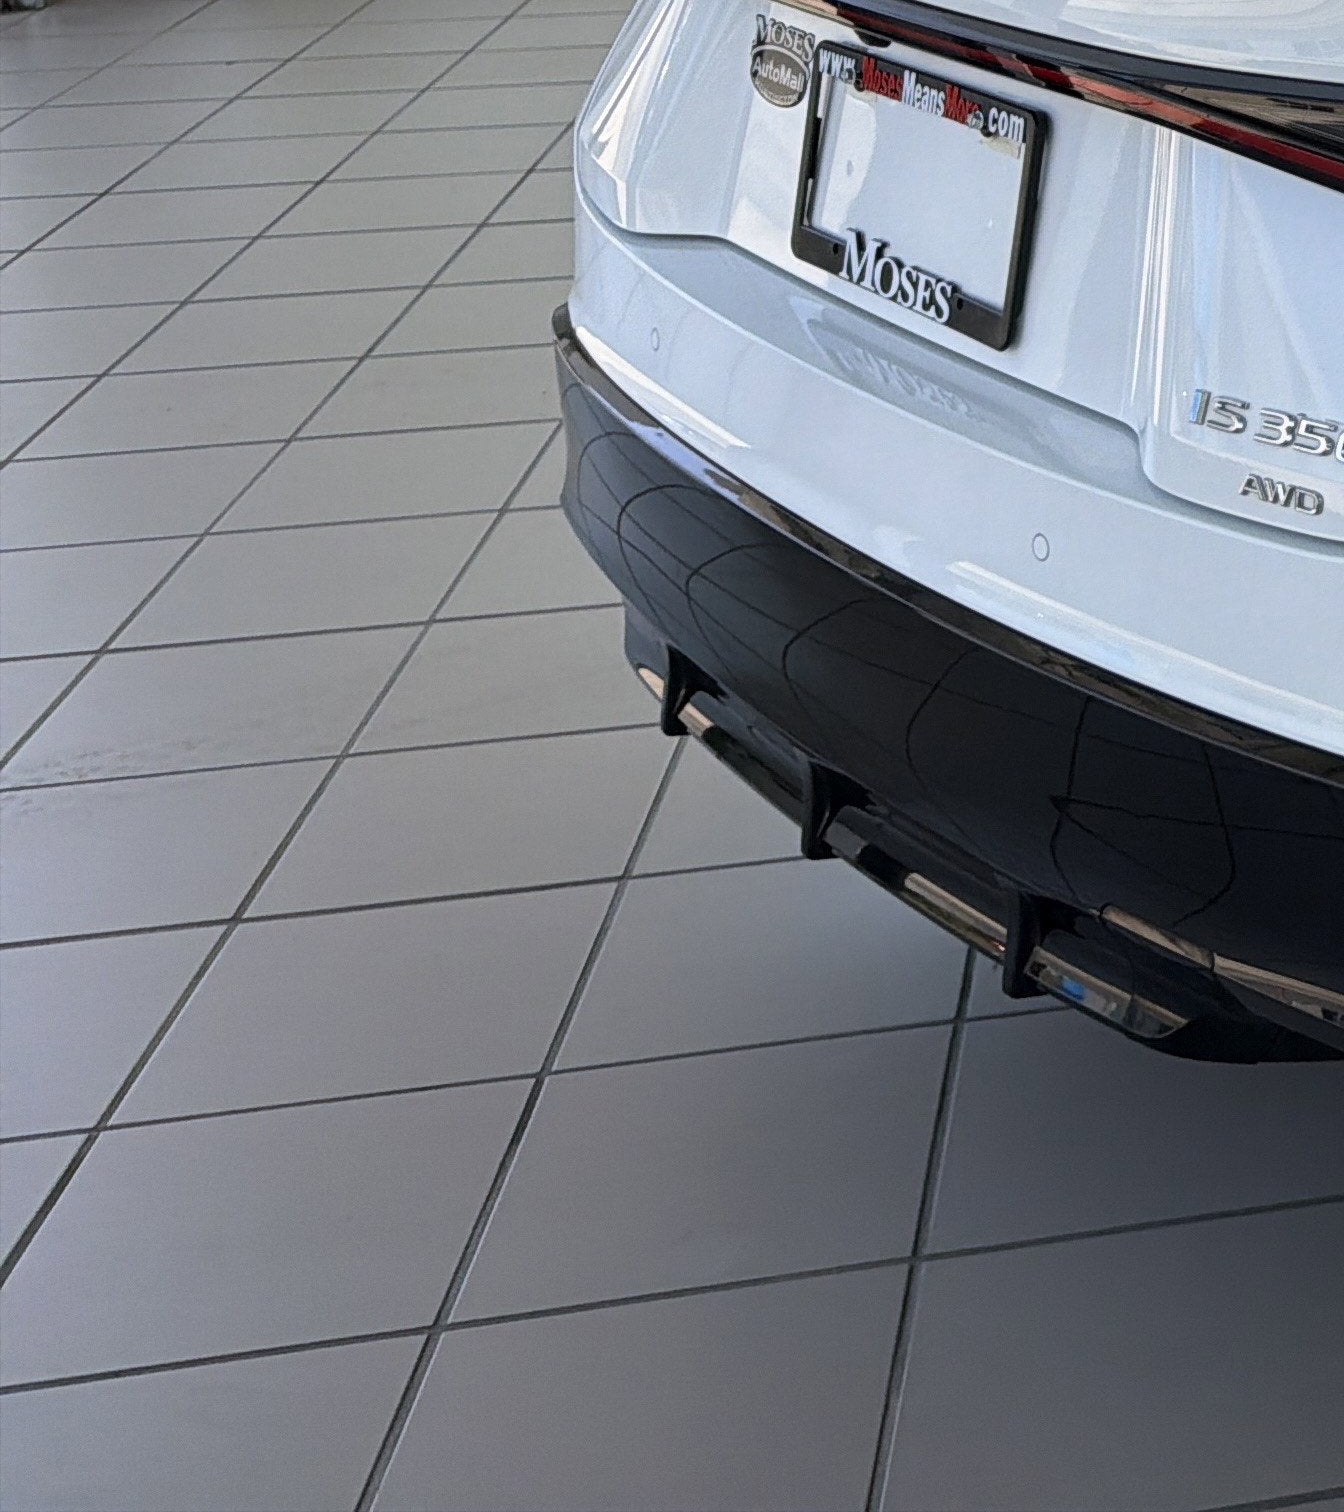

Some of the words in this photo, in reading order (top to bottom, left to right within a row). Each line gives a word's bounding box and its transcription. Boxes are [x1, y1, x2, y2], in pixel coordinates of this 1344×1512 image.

[752, 14, 815, 62] MOSES
[753, 54, 805, 93] AutoMall
[838, 228, 953, 324] MOSES
[1189, 388, 1250, 434] IS
[1239, 473, 1325, 515] AWD
